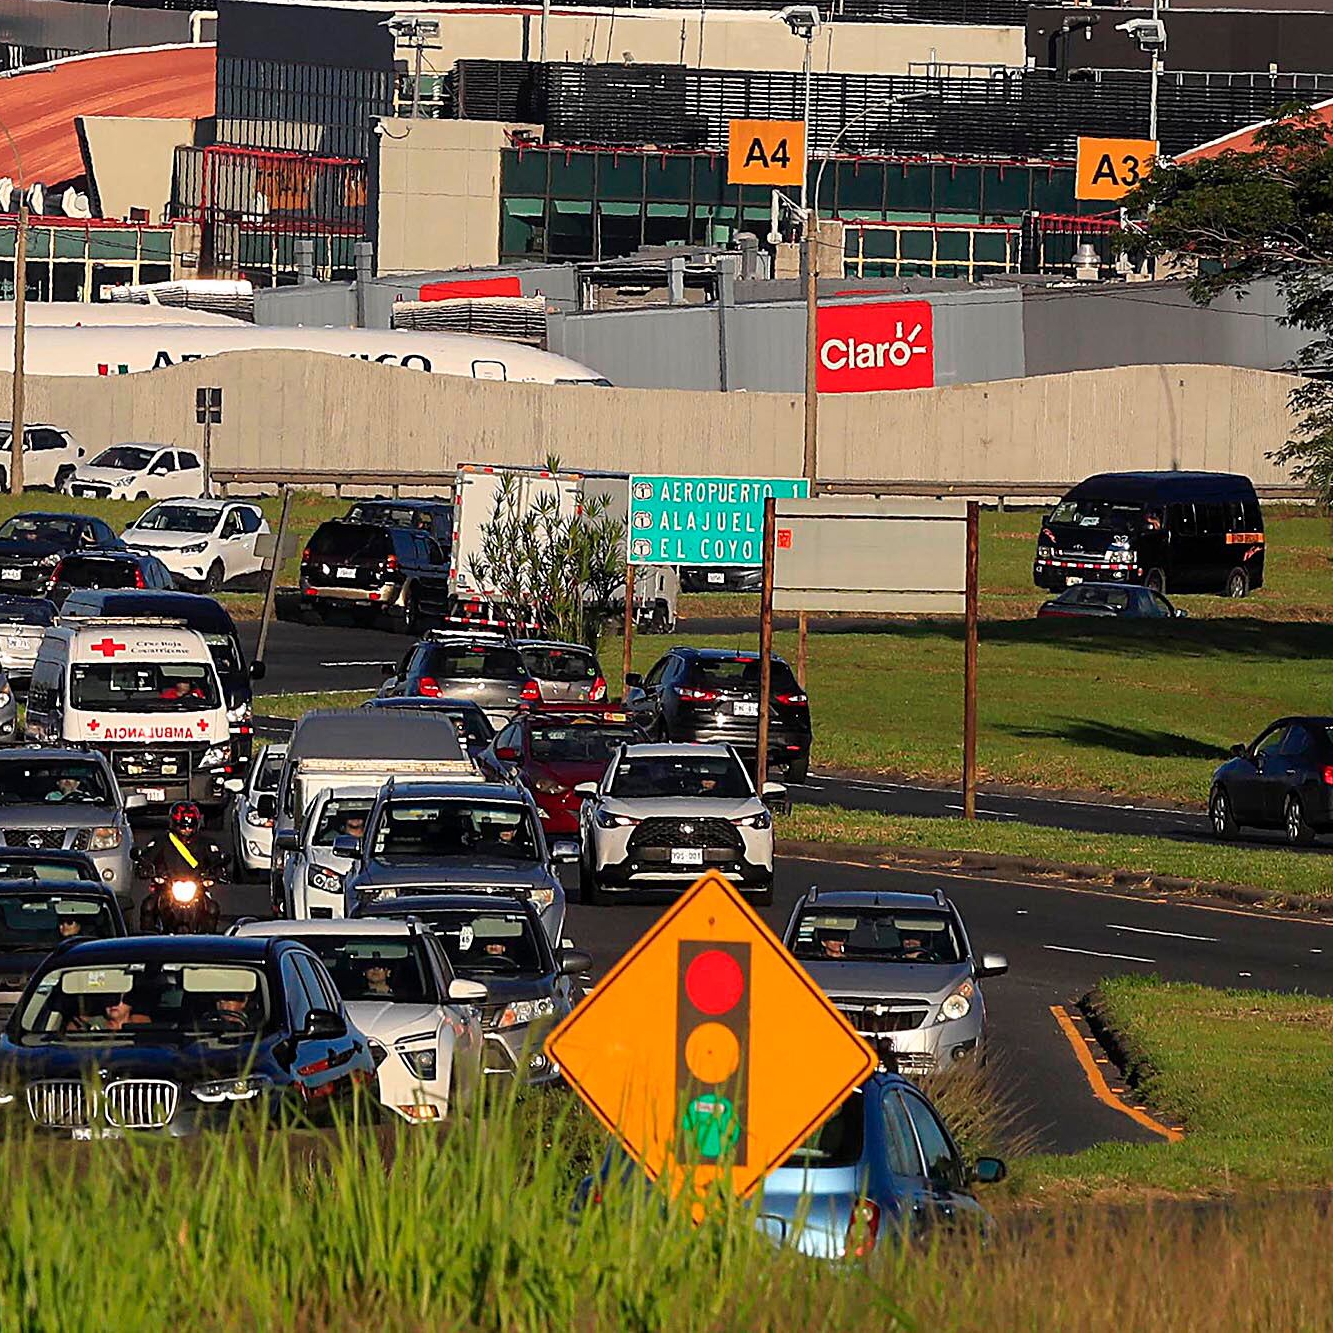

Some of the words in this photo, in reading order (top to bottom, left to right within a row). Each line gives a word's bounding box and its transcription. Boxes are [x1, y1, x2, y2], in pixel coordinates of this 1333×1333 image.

[743, 138, 790, 168] A4
[1091, 153, 1140, 187] A3
[820, 337, 913, 370] Claro
[660, 481, 773, 503] AEROPUERTO
[659, 511, 764, 533] ALAJUEL
[660, 538, 686, 559] EL
